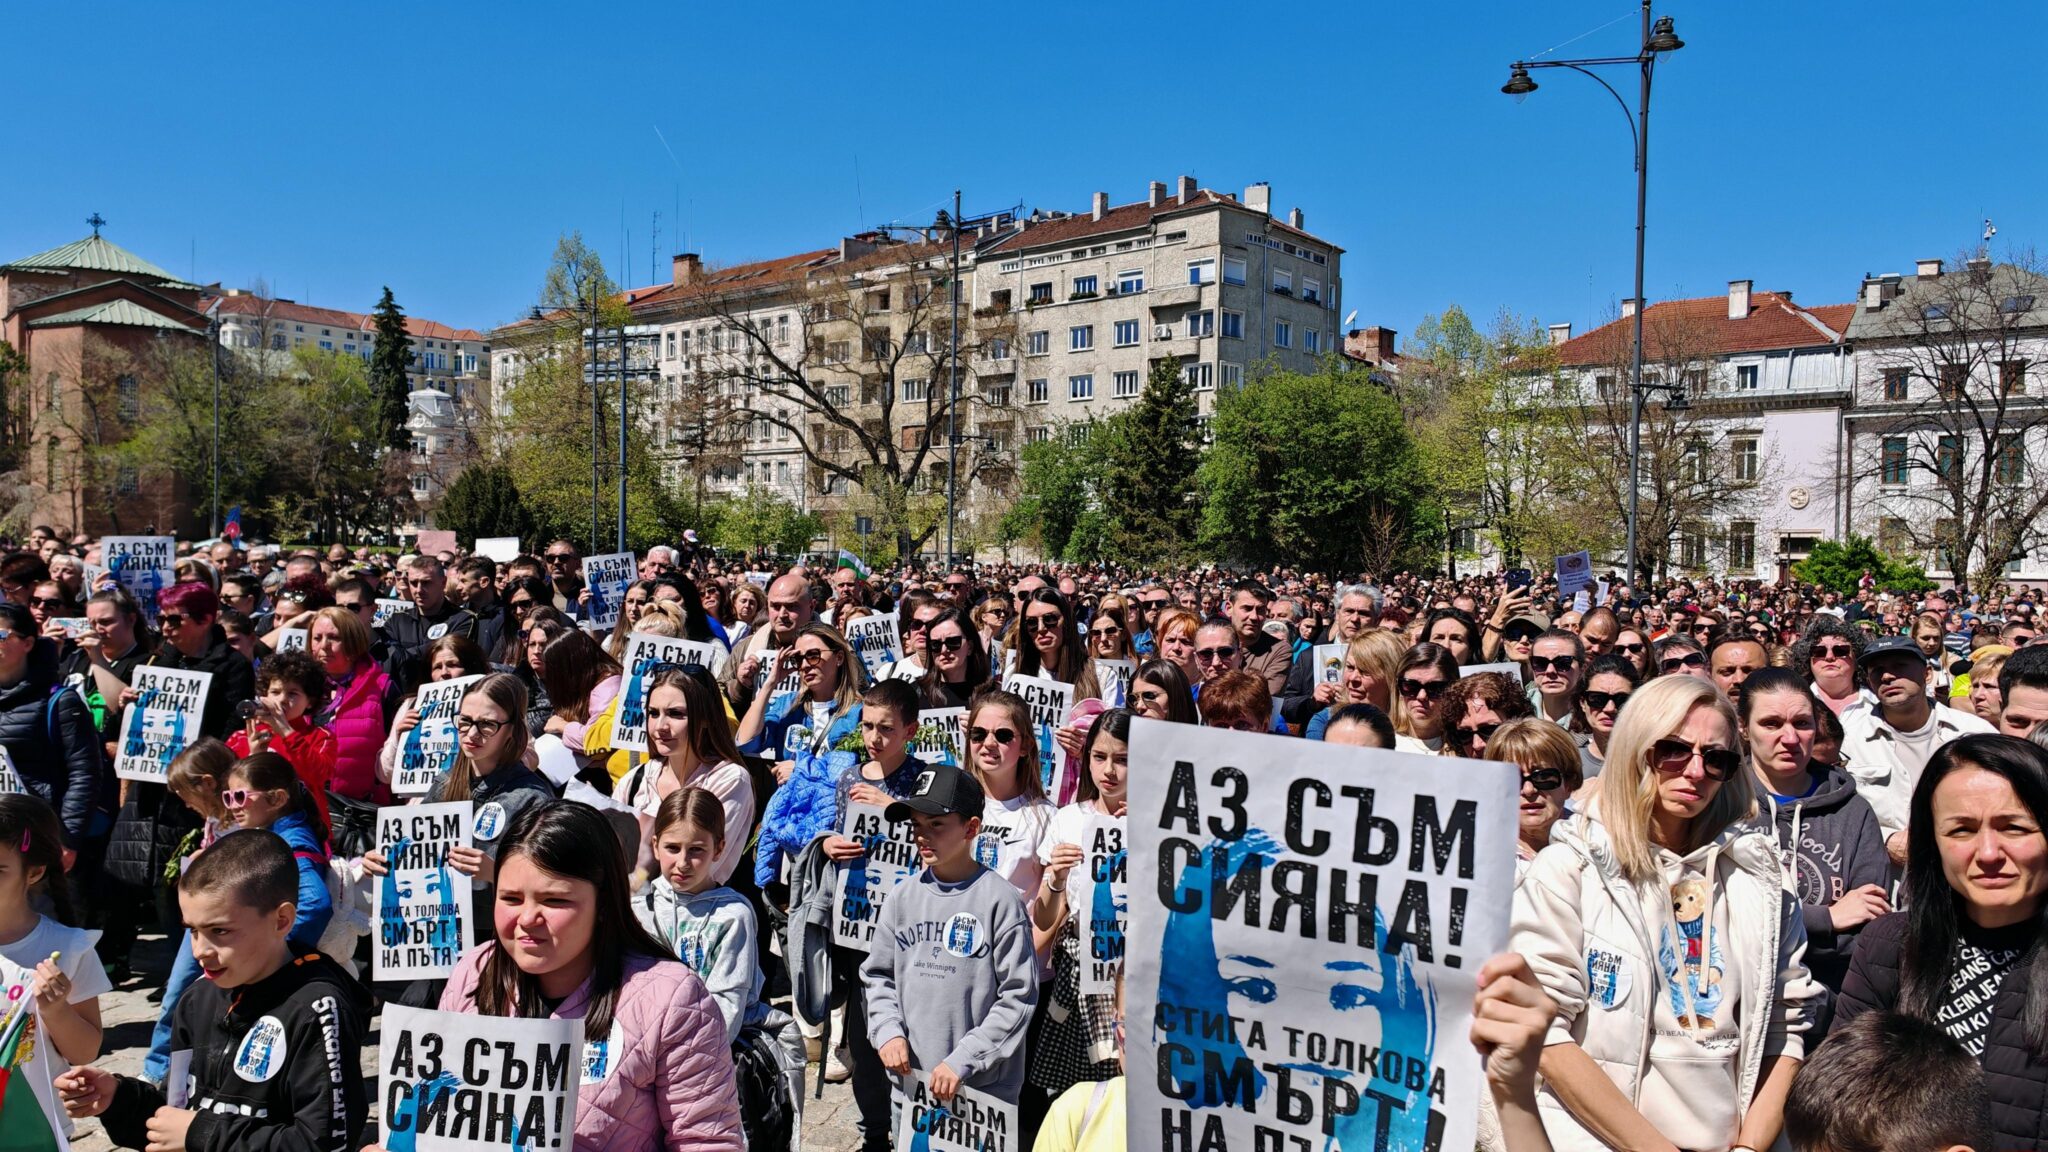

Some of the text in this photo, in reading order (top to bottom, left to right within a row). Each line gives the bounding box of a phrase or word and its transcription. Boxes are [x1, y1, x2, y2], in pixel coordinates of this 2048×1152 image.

[108, 542, 167, 556] АЗ СЪМ
[108, 557, 167, 571] СИЯНА!
[588, 558, 631, 573] АЗ СЪМ
[588, 569, 632, 584] СИЯНА!
[849, 620, 892, 638] АЗ СЪМ
[635, 642, 702, 665] АЗ СЪМ
[138, 674, 202, 696] АЗ СЪМ
[1024, 684, 1064, 709] СЪМ
[134, 690, 197, 713] СИЯНА!
[421, 690, 439, 706] АЗ
[1031, 704, 1062, 729] НА!
[618, 728, 633, 742] НА
[124, 740, 178, 760] СМЪРТ
[402, 753, 458, 770] СМЪРТ
[121, 758, 135, 771] НА
[400, 772, 415, 784] НА
[381, 818, 403, 844] АЗ
[411, 813, 460, 842] СЪМ
[853, 813, 880, 836] АЗ
[1159, 761, 1478, 881] АЗ СЪМ
[1092, 828, 1122, 854] АЗ
[1091, 854, 1128, 884] СИ
[381, 903, 460, 920] СТИГА ТОЛКОВА
[1157, 837, 1469, 969] СИЯНА!
[381, 919, 451, 946] СМЪРТ
[840, 920, 859, 939] НА
[382, 946, 452, 969] НА ПЪТЯ
[1091, 935, 1126, 960] СМ
[1600, 952, 1622, 965] СЪМ
[1949, 956, 1991, 994] JEANS
[1937, 989, 1982, 1023] KLEIN
[264, 1023, 282, 1037] СЪМ
[390, 1030, 571, 1092] АЗ СЪМ
[1156, 1001, 1446, 1105] СТИГА ТОЛКОВА
[1156, 1042, 1407, 1152] СМЪРТ
[386, 1079, 566, 1148] СИЯНА!
[951, 1094, 1006, 1135] СЪМ
